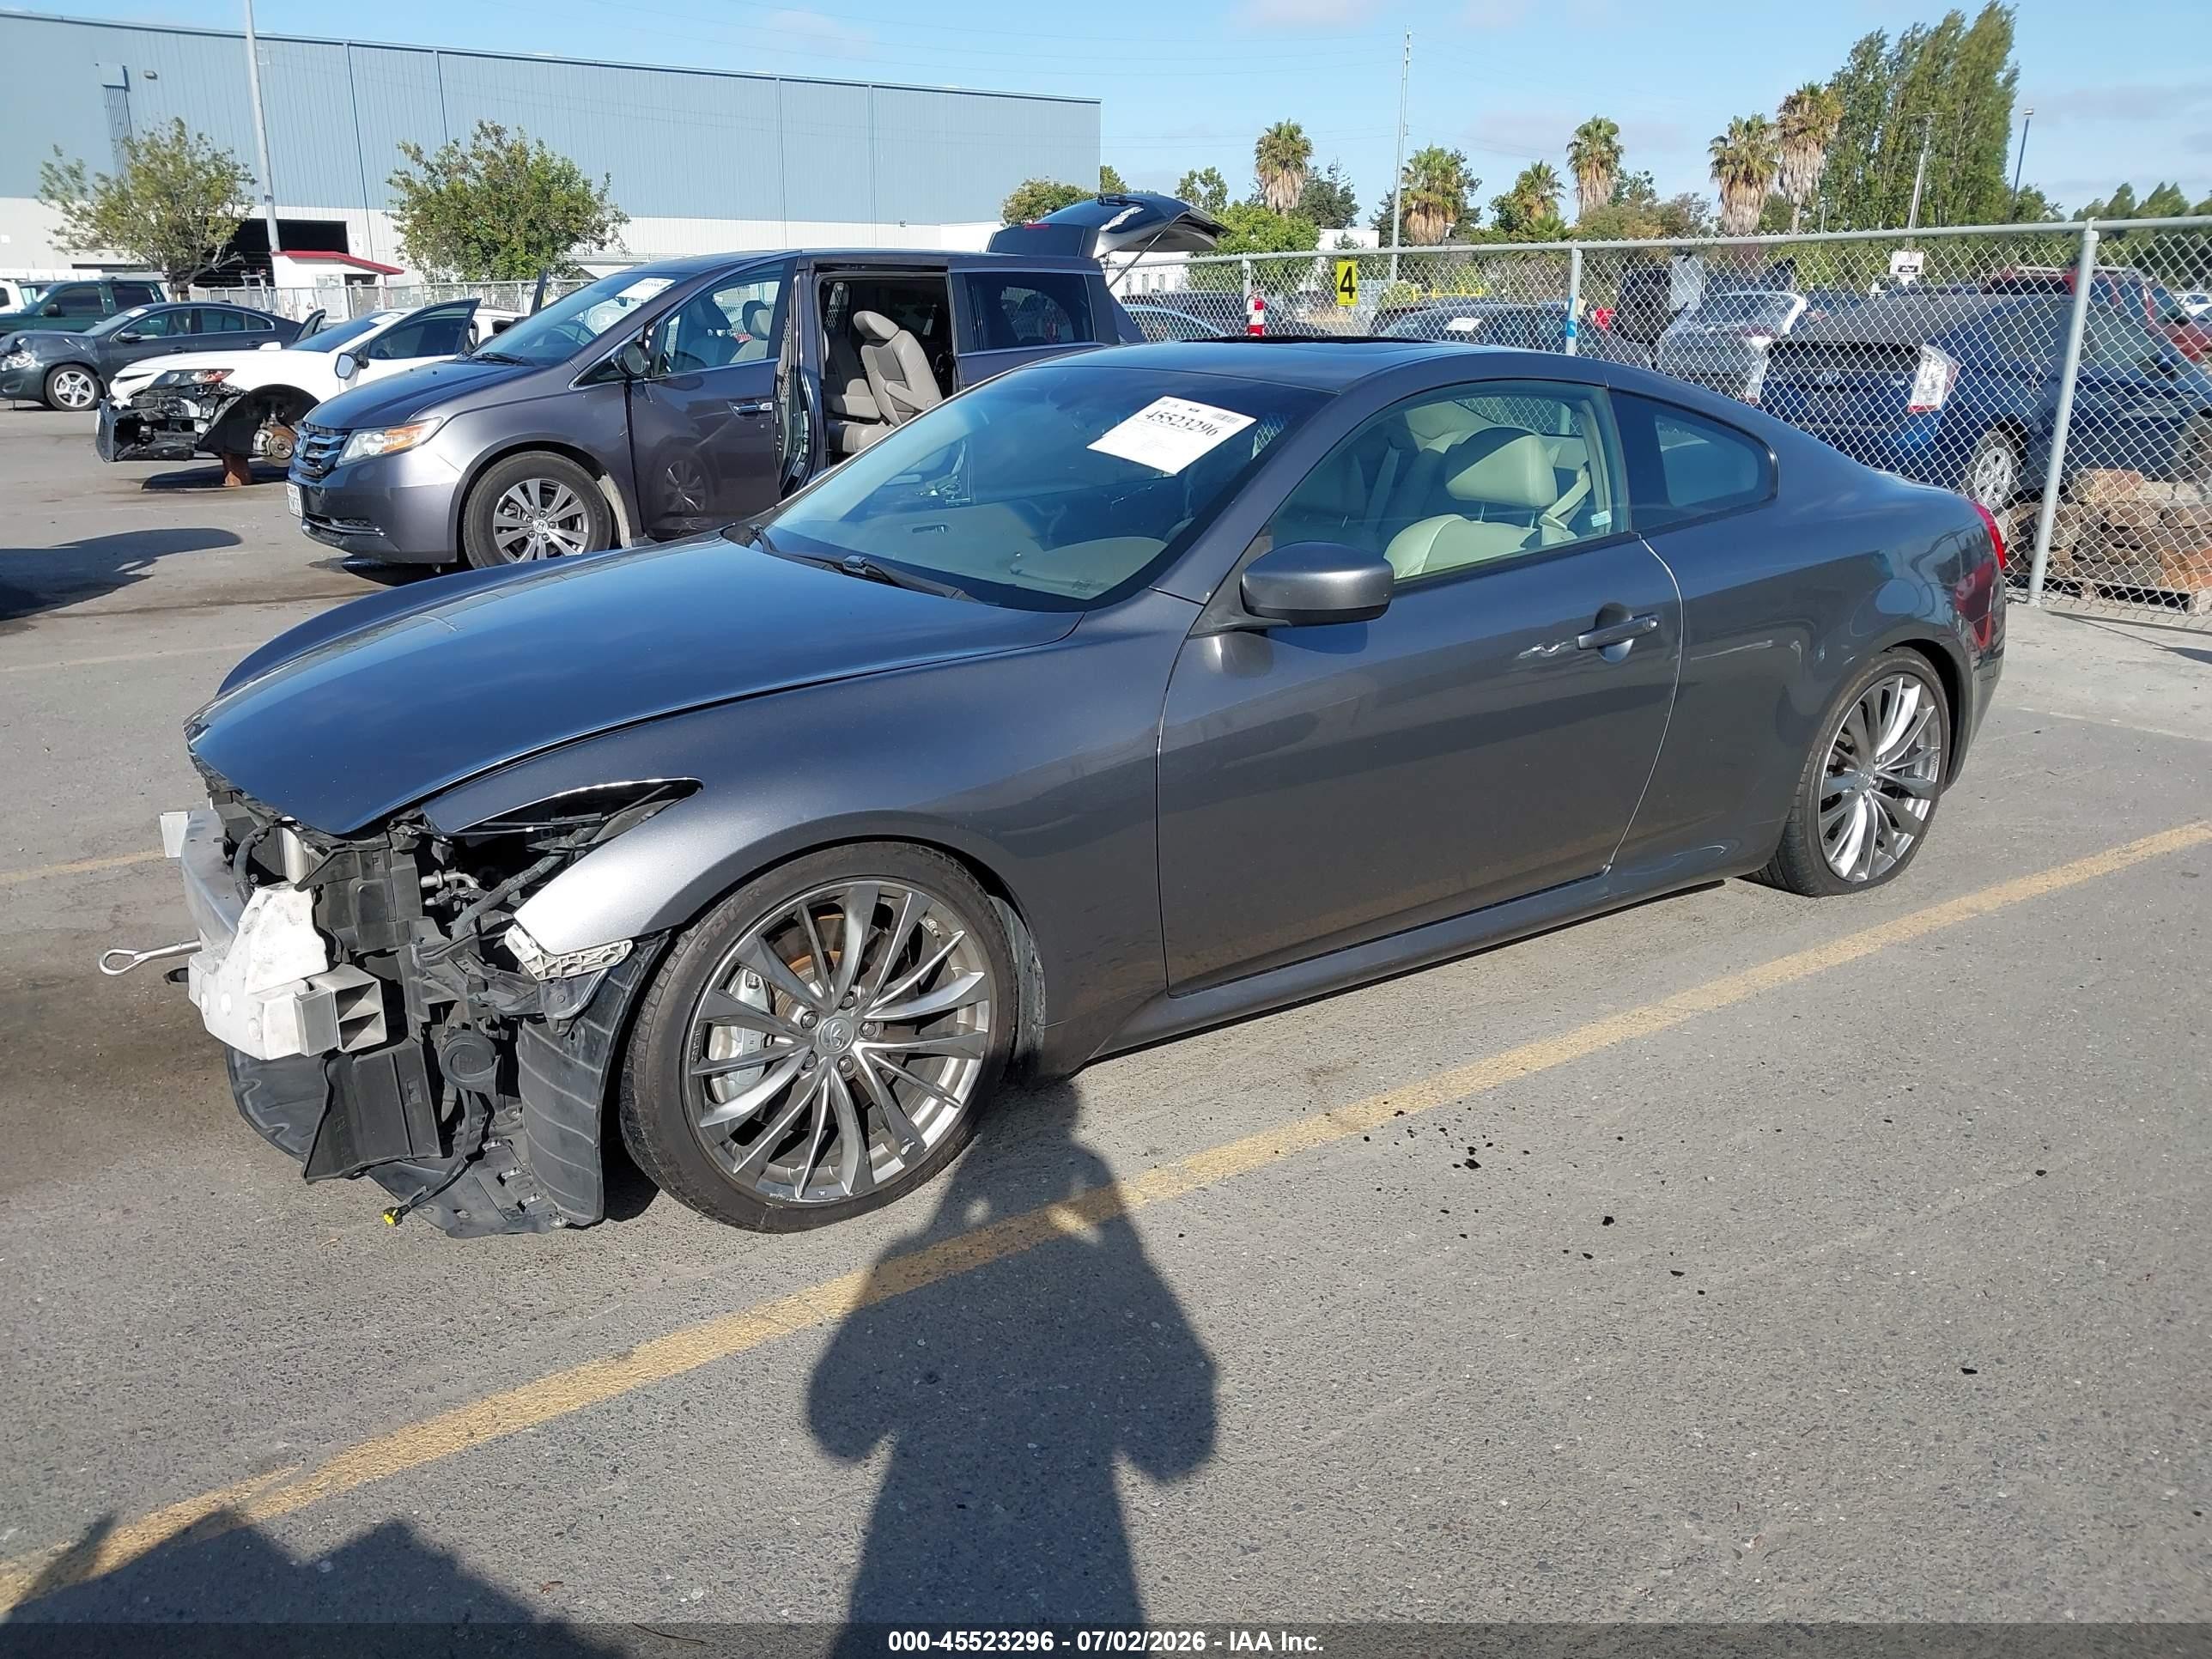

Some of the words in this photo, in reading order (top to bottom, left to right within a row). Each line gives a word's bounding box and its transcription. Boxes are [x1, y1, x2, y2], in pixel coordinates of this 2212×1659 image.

[1243, 268, 1249, 280] 2
[1340, 265, 1356, 300] 4
[1145, 410, 1223, 437] 45523296
